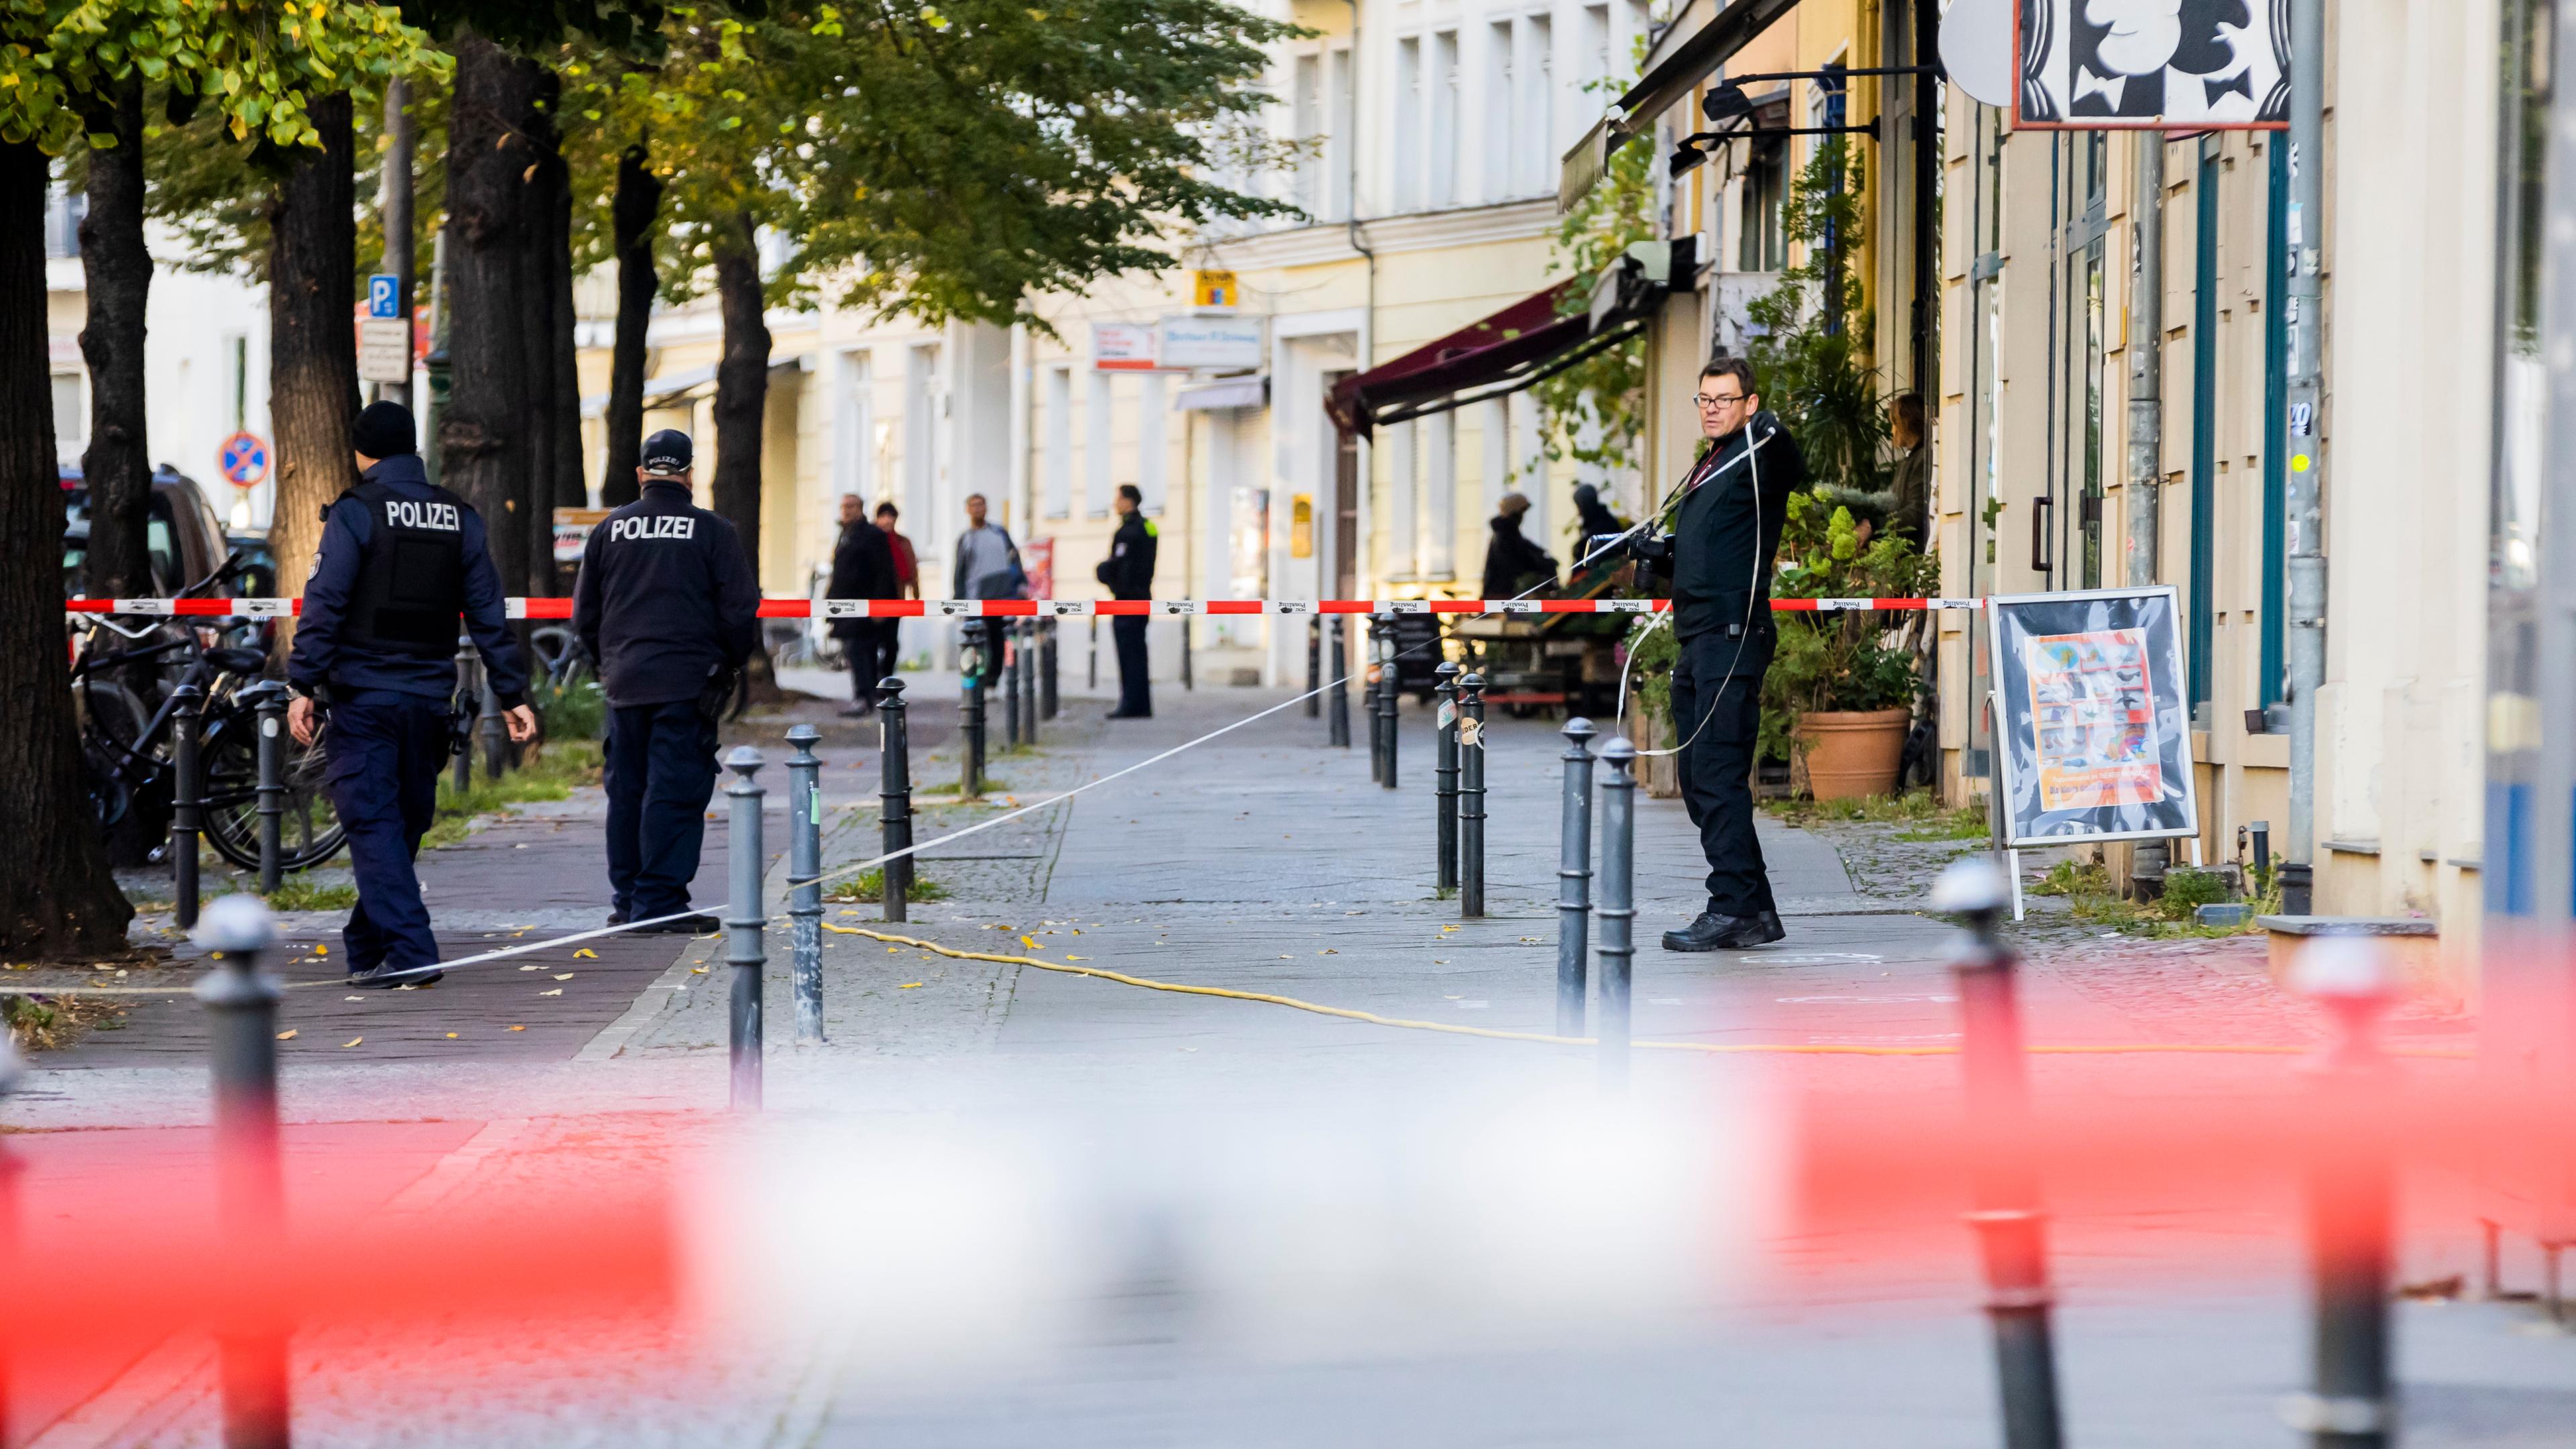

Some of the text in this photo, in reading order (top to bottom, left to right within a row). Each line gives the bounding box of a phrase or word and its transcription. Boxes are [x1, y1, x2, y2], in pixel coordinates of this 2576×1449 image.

[373, 280, 391, 313] P
[649, 456, 680, 466] POLIZEI
[386, 501, 460, 531] POLIZEI
[611, 516, 695, 542] POLIZEI
